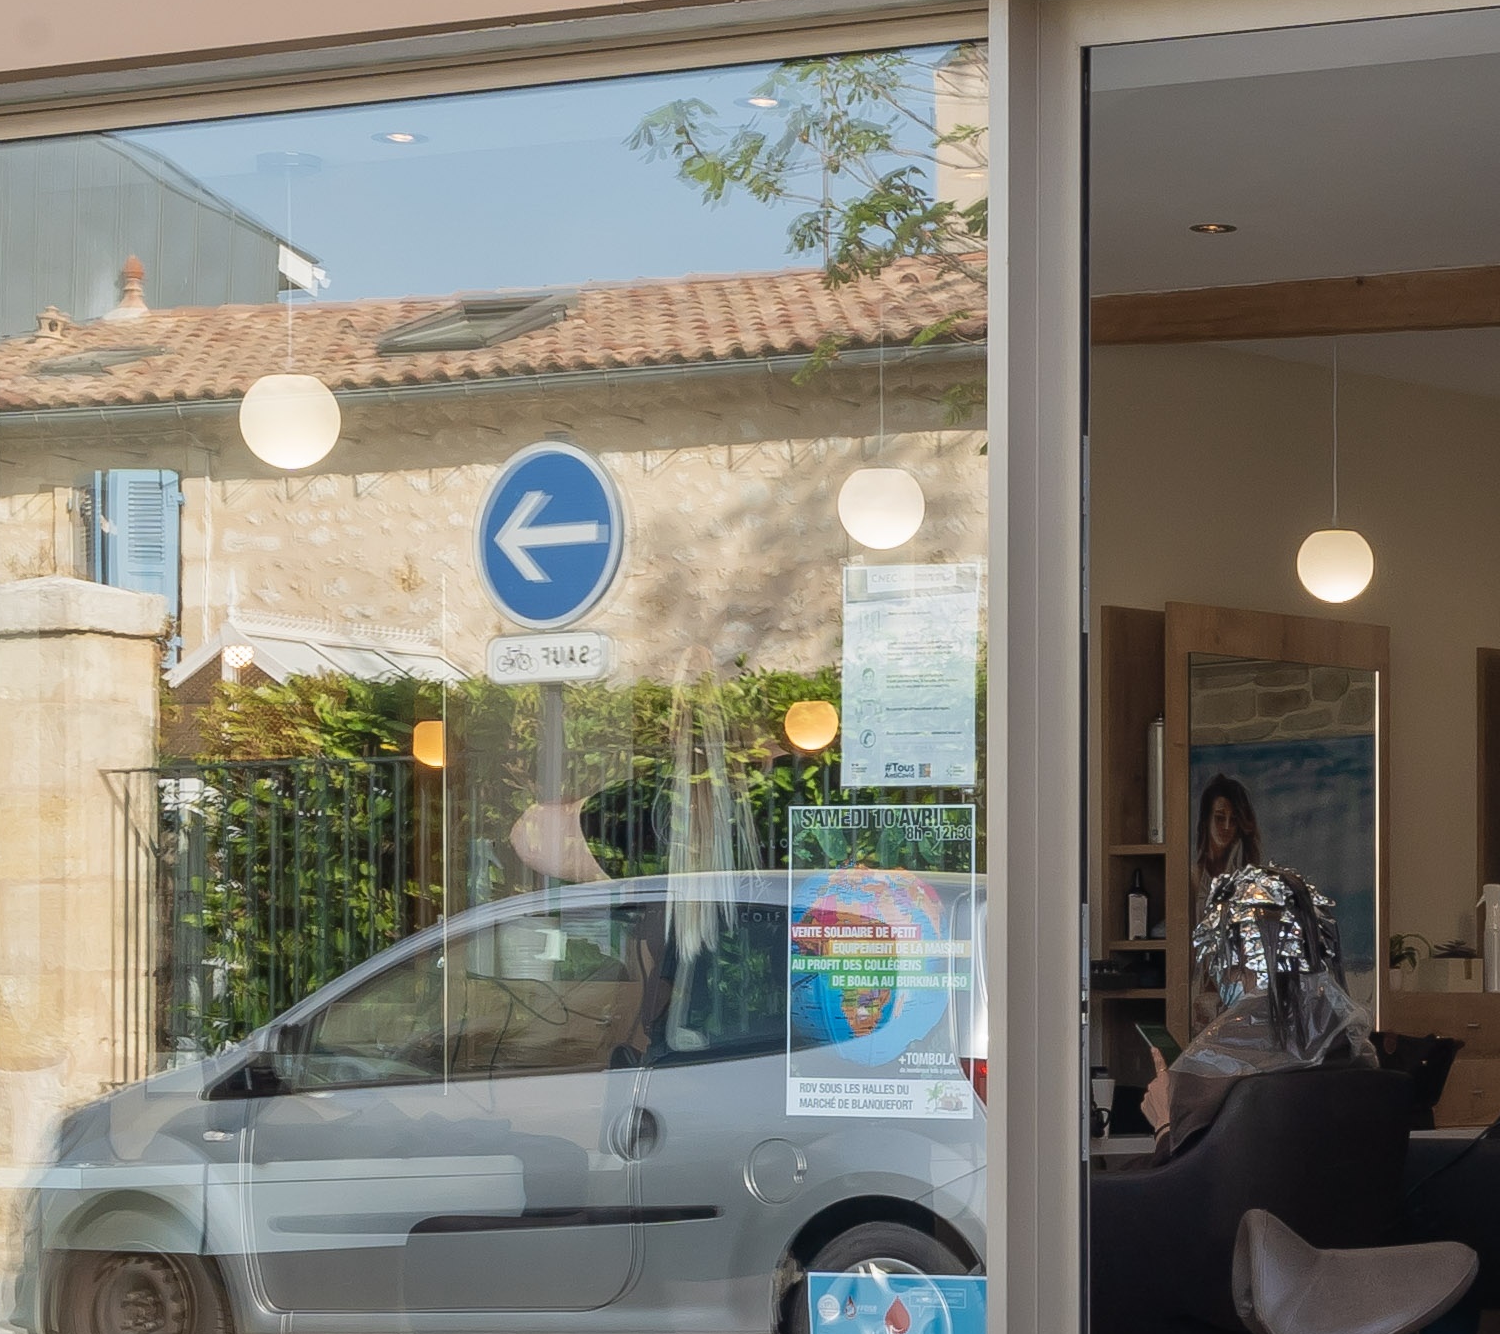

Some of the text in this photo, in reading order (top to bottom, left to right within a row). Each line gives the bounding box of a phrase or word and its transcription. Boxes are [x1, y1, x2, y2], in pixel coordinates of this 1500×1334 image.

[801, 808, 949, 829] SAMEDI 10 AVRIL
[791, 925, 917, 938] VENTE SOLIDAIRE DE PETIT
[792, 959, 806, 970] AU
[807, 959, 841, 971] PROFIT
[843, 959, 862, 971] DES
[832, 975, 846, 987] DE
[881, 975, 894, 987] AU
[897, 976, 939, 988] BURKINA
[799, 1082, 909, 1095] RDV SOUS LES HALLES DU
[799, 1096, 913, 1110] MARCHÉ DE BLANQUEFORT
